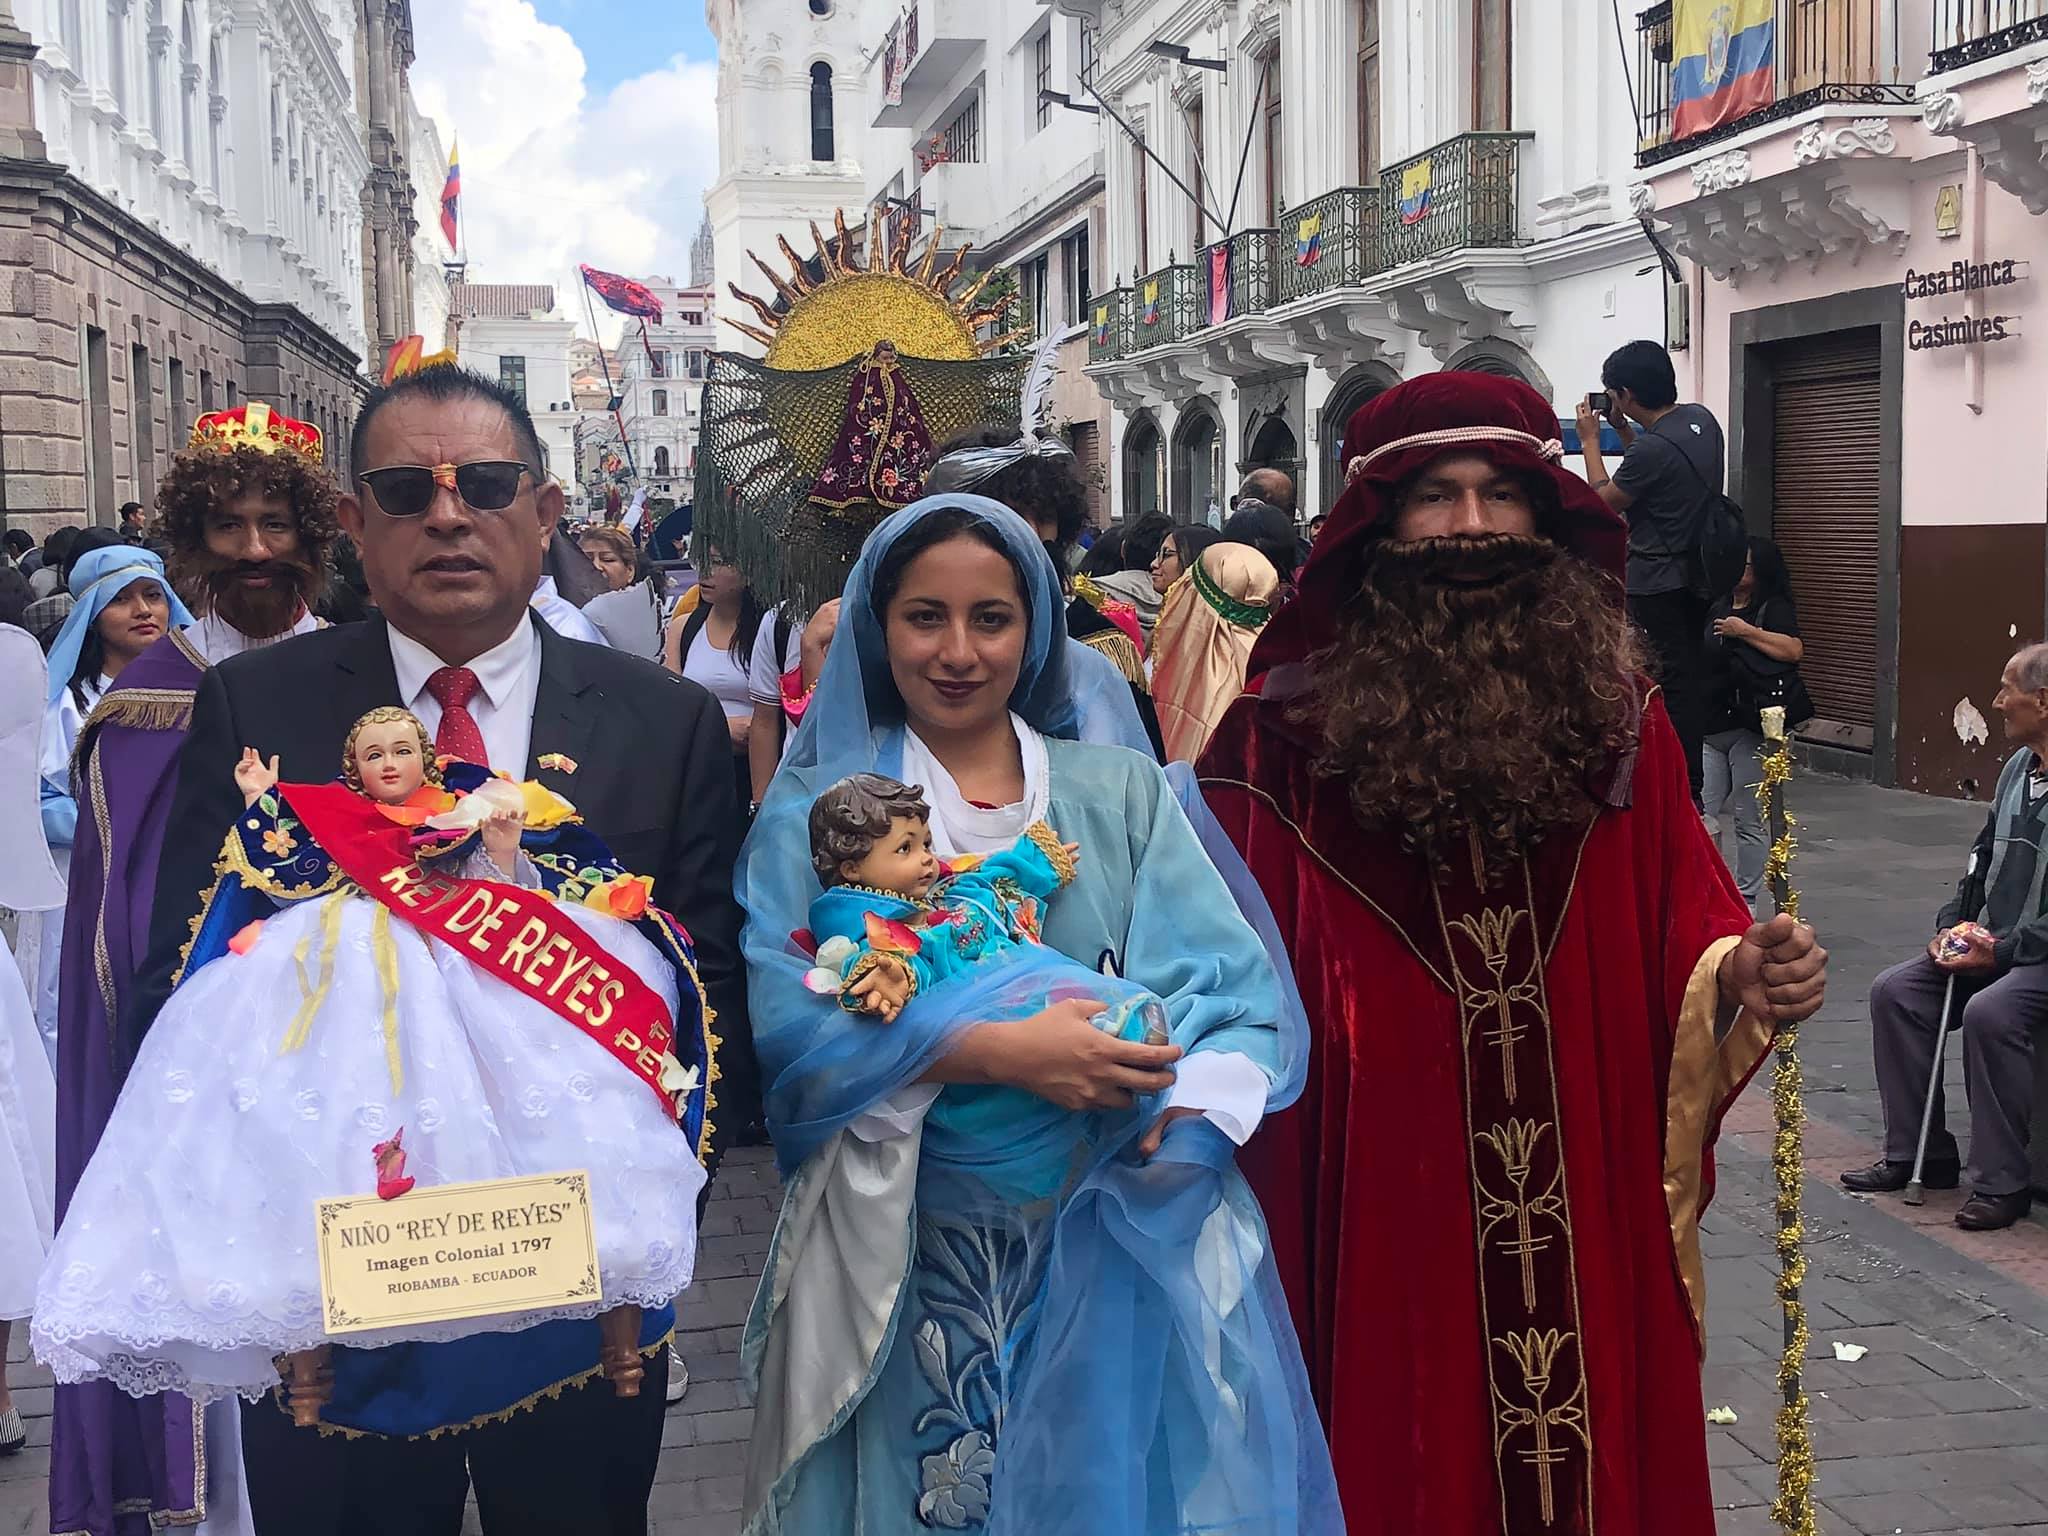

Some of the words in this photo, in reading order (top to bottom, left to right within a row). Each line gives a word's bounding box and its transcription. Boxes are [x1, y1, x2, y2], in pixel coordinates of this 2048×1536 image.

[1905, 268, 1948, 299] Casa
[1952, 259, 2015, 292] Blanca
[1909, 315, 2006, 351] Casimires
[444, 887, 522, 952] DE
[499, 915, 625, 1027] REYES
[340, 1220, 390, 1248] NIÑO
[457, 1213, 486, 1234] DE
[366, 1255, 429, 1272] Imagen
[435, 1242, 505, 1263] Colonial
[512, 1237, 552, 1254] 1797
[387, 1276, 460, 1294] RIOBAMBA
[472, 1266, 538, 1283] ECUADOR
